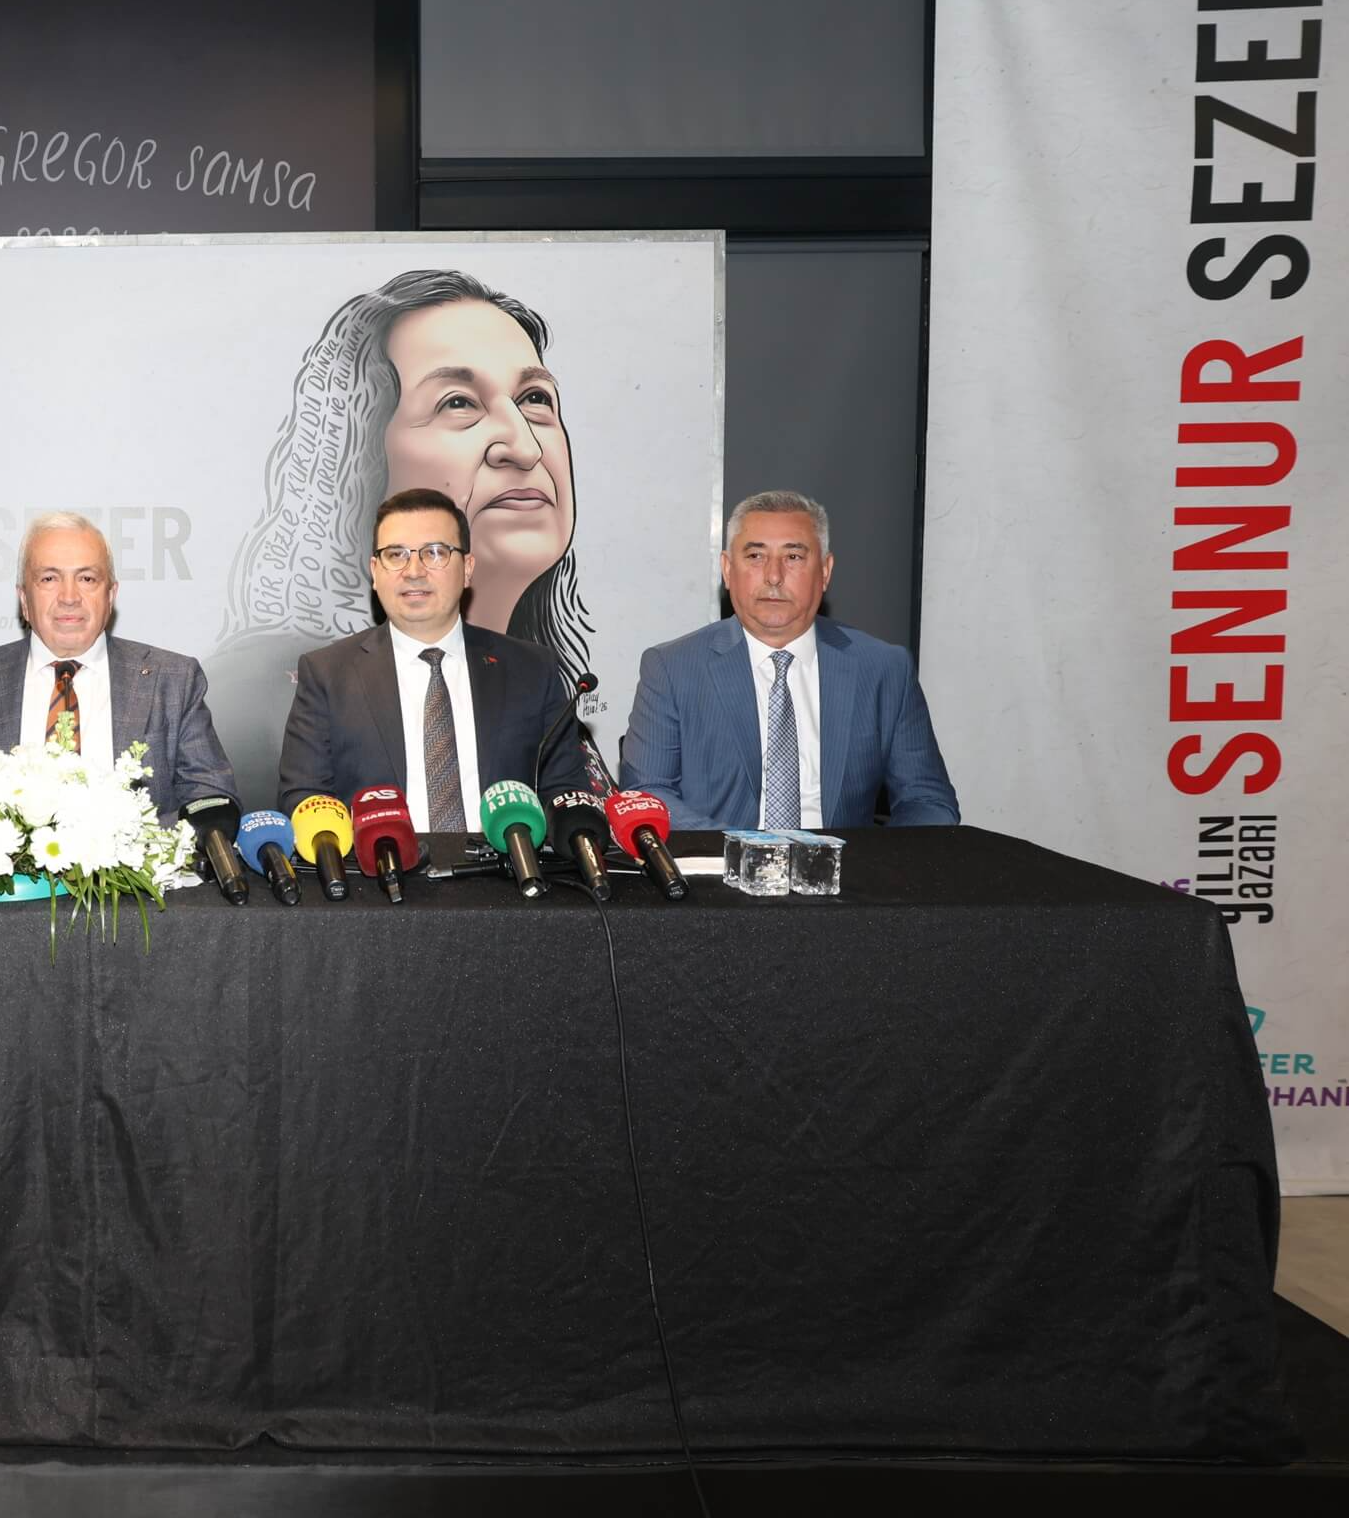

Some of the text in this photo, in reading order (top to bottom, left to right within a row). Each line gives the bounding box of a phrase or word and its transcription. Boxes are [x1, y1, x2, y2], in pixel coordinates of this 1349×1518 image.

[1167, 0, 1323, 796] SENNUR SEZE
[359, 789, 398, 803] AS
[361, 810, 401, 822] HABER
